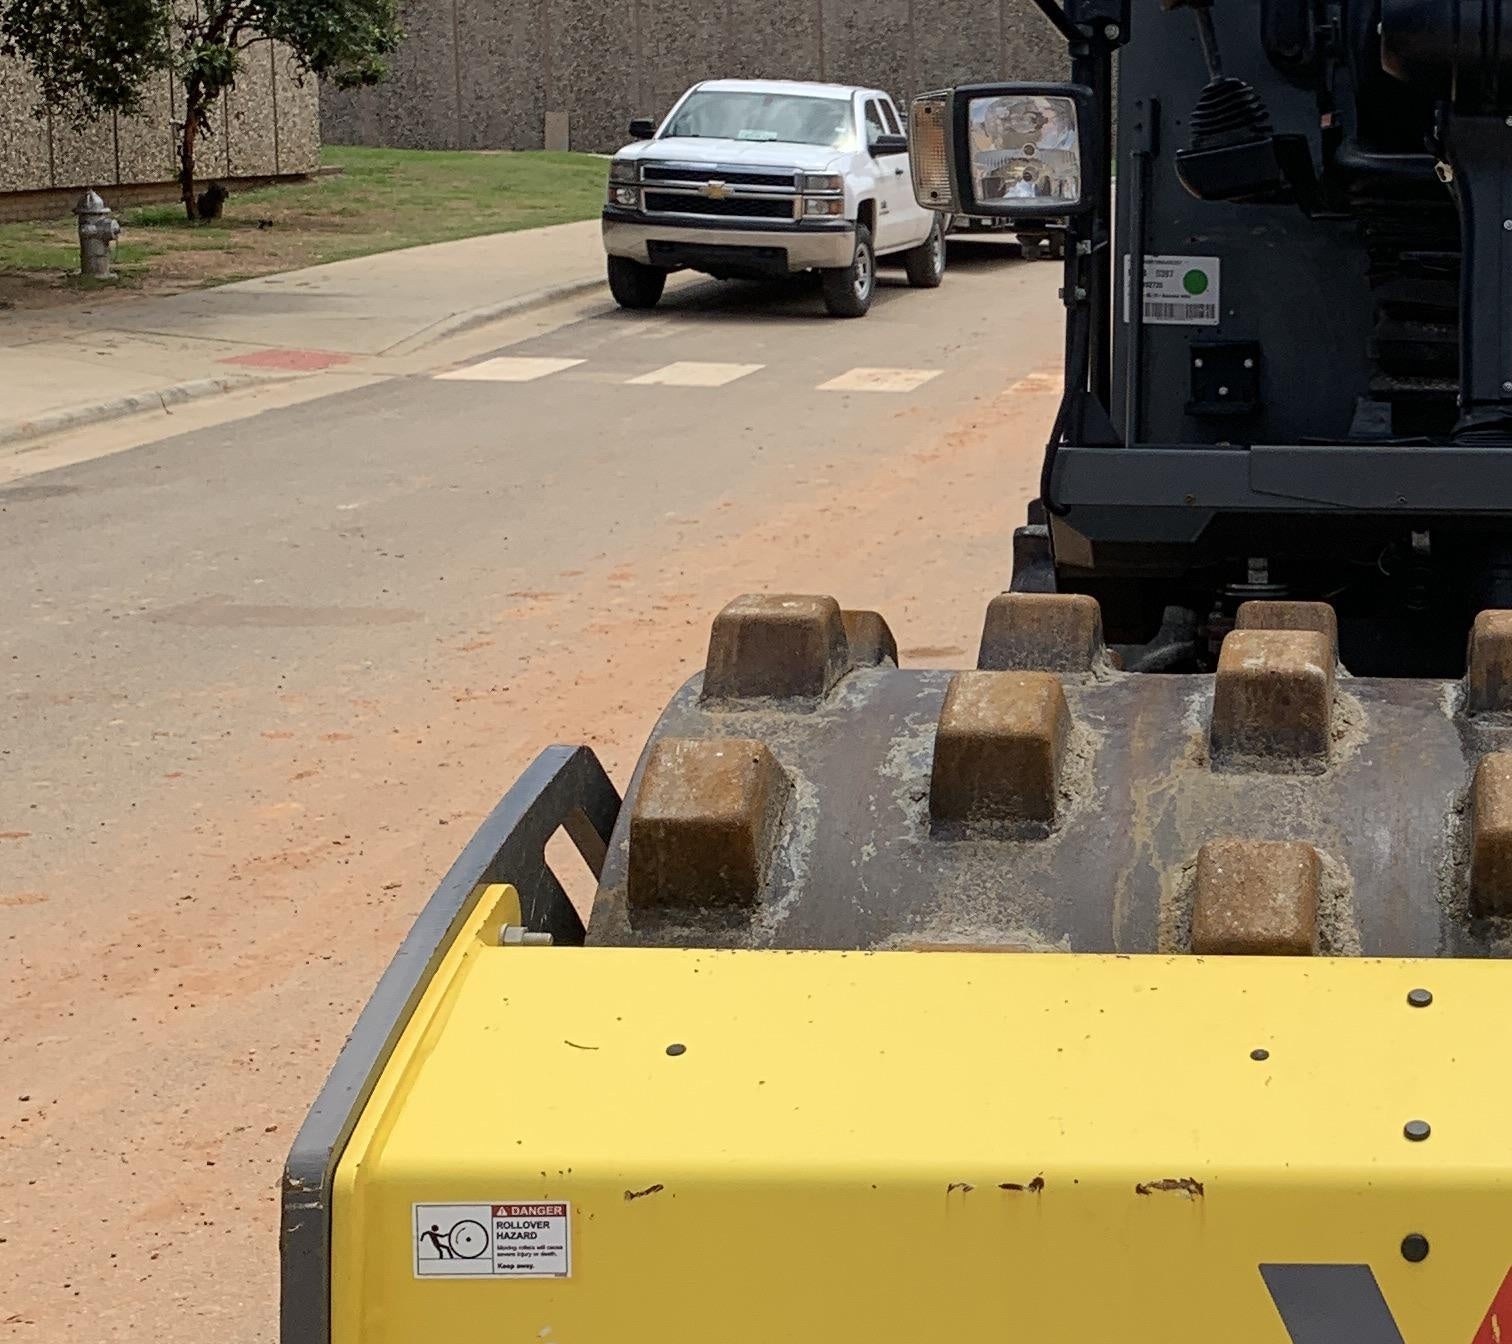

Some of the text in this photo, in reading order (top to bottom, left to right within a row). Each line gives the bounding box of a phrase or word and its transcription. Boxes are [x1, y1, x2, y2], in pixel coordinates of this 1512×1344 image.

[511, 1206, 562, 1215] DANGER
[496, 1221, 550, 1229] ROLLOVER
[496, 1232, 537, 1240] HAZARD
